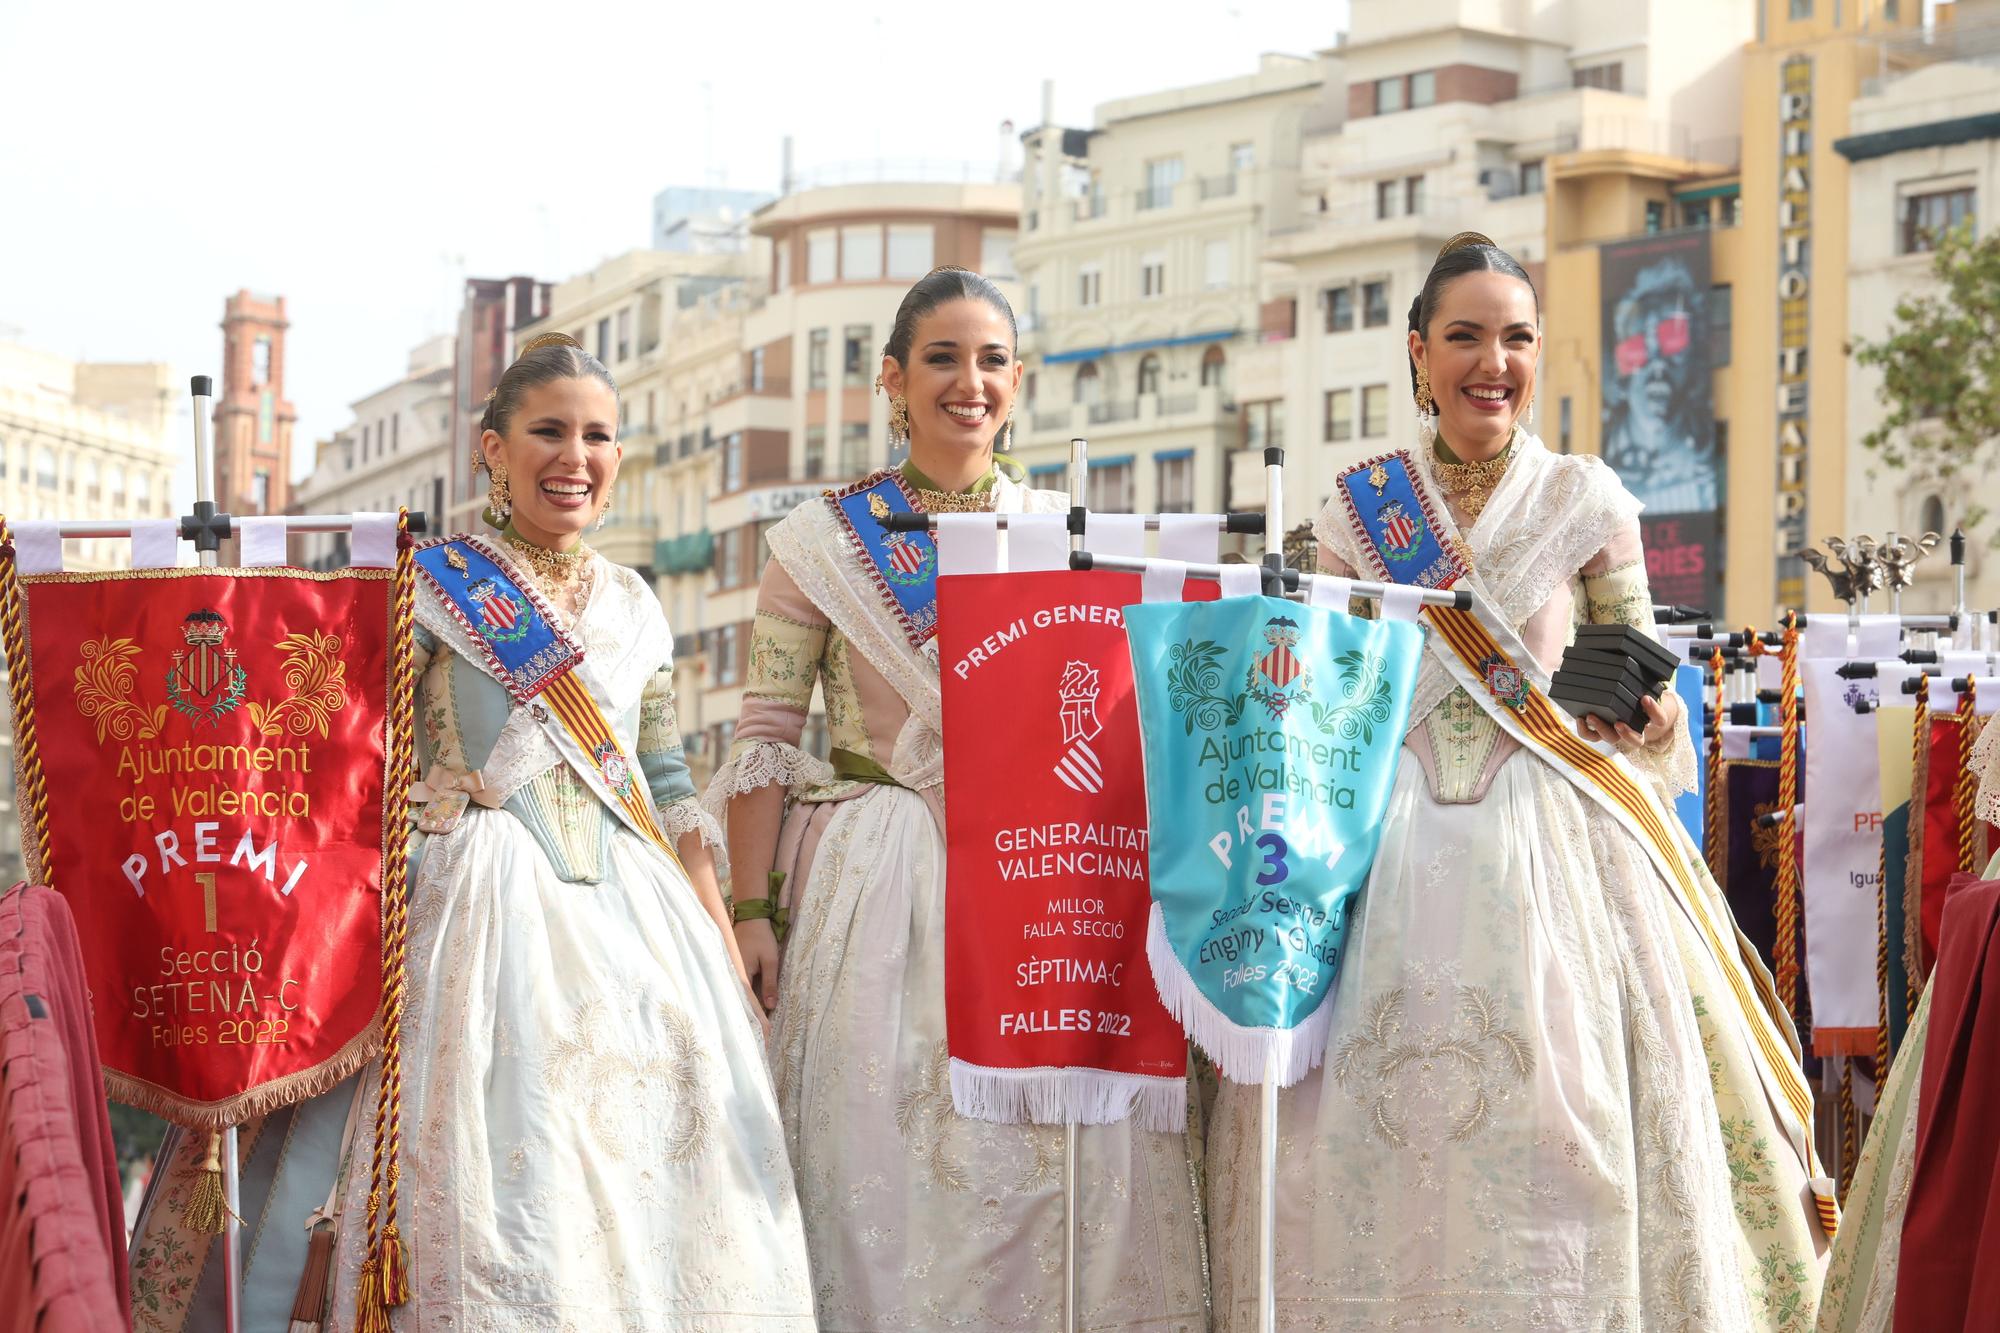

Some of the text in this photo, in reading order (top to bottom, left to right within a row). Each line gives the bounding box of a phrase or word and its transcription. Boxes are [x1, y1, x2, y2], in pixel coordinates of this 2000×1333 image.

[1780, 93, 1810, 300] RIALTO
[953, 619, 1028, 680] PREMI
[116, 740, 312, 785] Ajuntament
[1198, 726, 1361, 772] Ajuntament
[119, 782, 311, 823] de València
[1205, 761, 1355, 810] de València
[995, 822, 1149, 852] GENERALITAT
[1208, 793, 1345, 871] PREMI
[121, 822, 309, 898] PREMI
[998, 852, 1144, 881] VALENCIANA
[1255, 833, 1289, 886] 3
[195, 872, 217, 933] 1
[1047, 898, 1105, 915] MILLOR
[1023, 920, 1124, 939] FALLA SECCIÓ
[1200, 922, 1338, 967] Enginy i Grcia
[160, 938, 262, 976] Secció
[1016, 955, 1123, 987] SÈPTIMA-C
[1223, 960, 1319, 995] Falles 2022
[133, 979, 299, 1019] SETENA-C
[152, 1019, 289, 1048] Falles 2022
[1000, 1009, 1132, 1037] FALLES 2022
